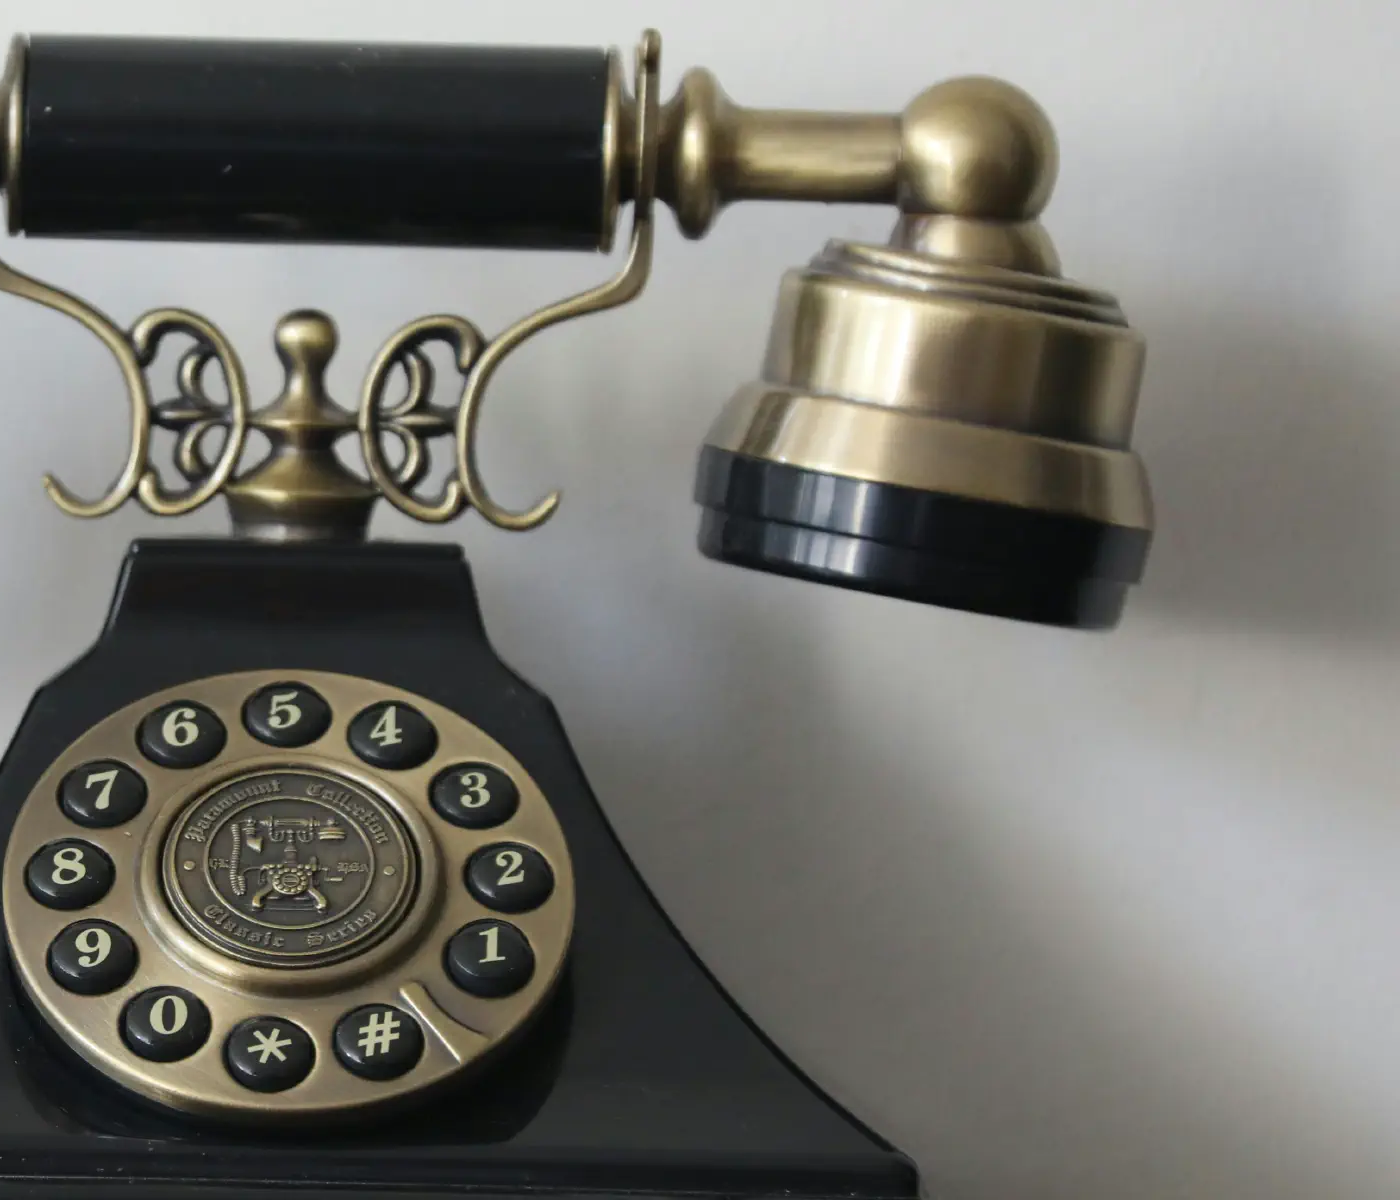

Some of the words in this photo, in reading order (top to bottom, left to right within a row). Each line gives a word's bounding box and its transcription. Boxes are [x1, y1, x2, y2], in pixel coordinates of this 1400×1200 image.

[163, 708, 199, 747] 6
[269, 692, 302, 729] 5
[370, 706, 403, 747] 4
[86, 770, 119, 810] 7
[460, 772, 491, 808] 3
[184, 779, 282, 842] Paramount
[305, 783, 389, 844] Collection
[52, 848, 87, 885] 8
[495, 851, 525, 886] 2
[204, 904, 284, 948] Classic
[307, 909, 377, 947] Series
[478, 927, 506, 963] 1
[75, 929, 112, 968] 9
[150, 996, 188, 1035] 0
[358, 1011, 401, 1057] #
